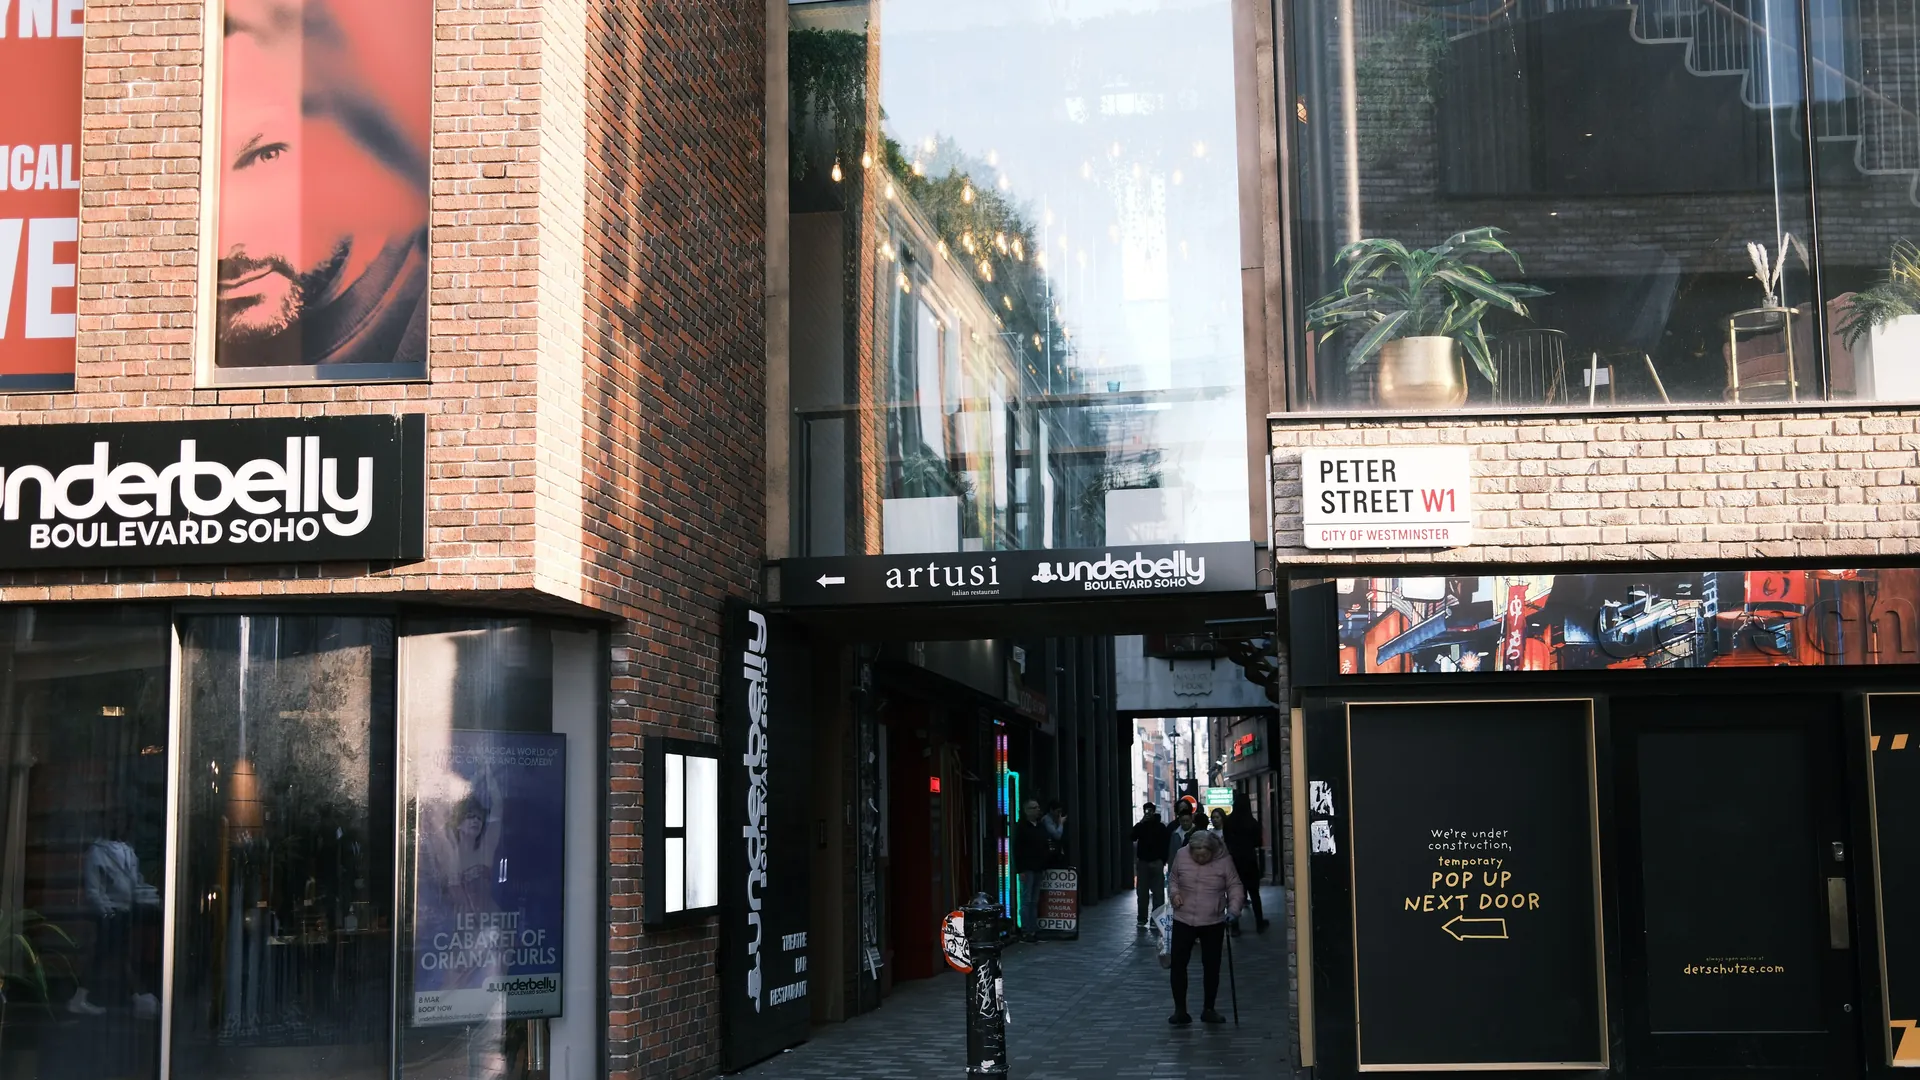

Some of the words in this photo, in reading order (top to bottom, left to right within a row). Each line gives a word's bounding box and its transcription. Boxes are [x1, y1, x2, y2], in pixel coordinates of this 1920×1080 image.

[1320, 459, 1396, 483] PETER
[0, 436, 374, 537] nderbelly
[1321, 489, 1414, 514] STREET
[1421, 488, 1455, 512] W1
[30, 518, 223, 549] BOULEVARD
[228, 516, 320, 543] SOHO
[1321, 530, 1347, 541] CITY
[1350, 530, 1363, 541] OF
[1366, 528, 1449, 541] WESTMINSTER
[886, 557, 1000, 589] artusi
[1056, 549, 1206, 586] underbelly
[1084, 578, 1153, 591] BOULEVARD
[1154, 577, 1187, 588] SOHO
[760, 657, 768, 728] SOHO
[517, 747, 546, 756] WORLD
[517, 757, 554, 766] COMEDY
[743, 609, 768, 955] underbelly
[760, 733, 768, 888] BOULEVARD
[1431, 828, 1467, 839] We're
[1472, 828, 1509, 839] under
[1428, 839, 1512, 852] construction,
[1438, 856, 1503, 869] temporary
[1431, 871, 1473, 889] POP
[1483, 870, 1512, 888] UP
[1404, 894, 1469, 912] NEXT
[1479, 892, 1540, 910] DOOR
[457, 912, 474, 931] LE
[480, 911, 520, 930] PETIT
[1038, 919, 1073, 929] OPEN
[433, 930, 518, 950] CABARET
[521, 929, 546, 947] OF
[421, 952, 497, 970] ORIANA
[502, 947, 556, 966] CURLS
[795, 955, 808, 973] BAR
[1683, 963, 1785, 975] derschutze.com
[497, 976, 557, 993] underbelly
[770, 980, 808, 1006] RESTAURANT
